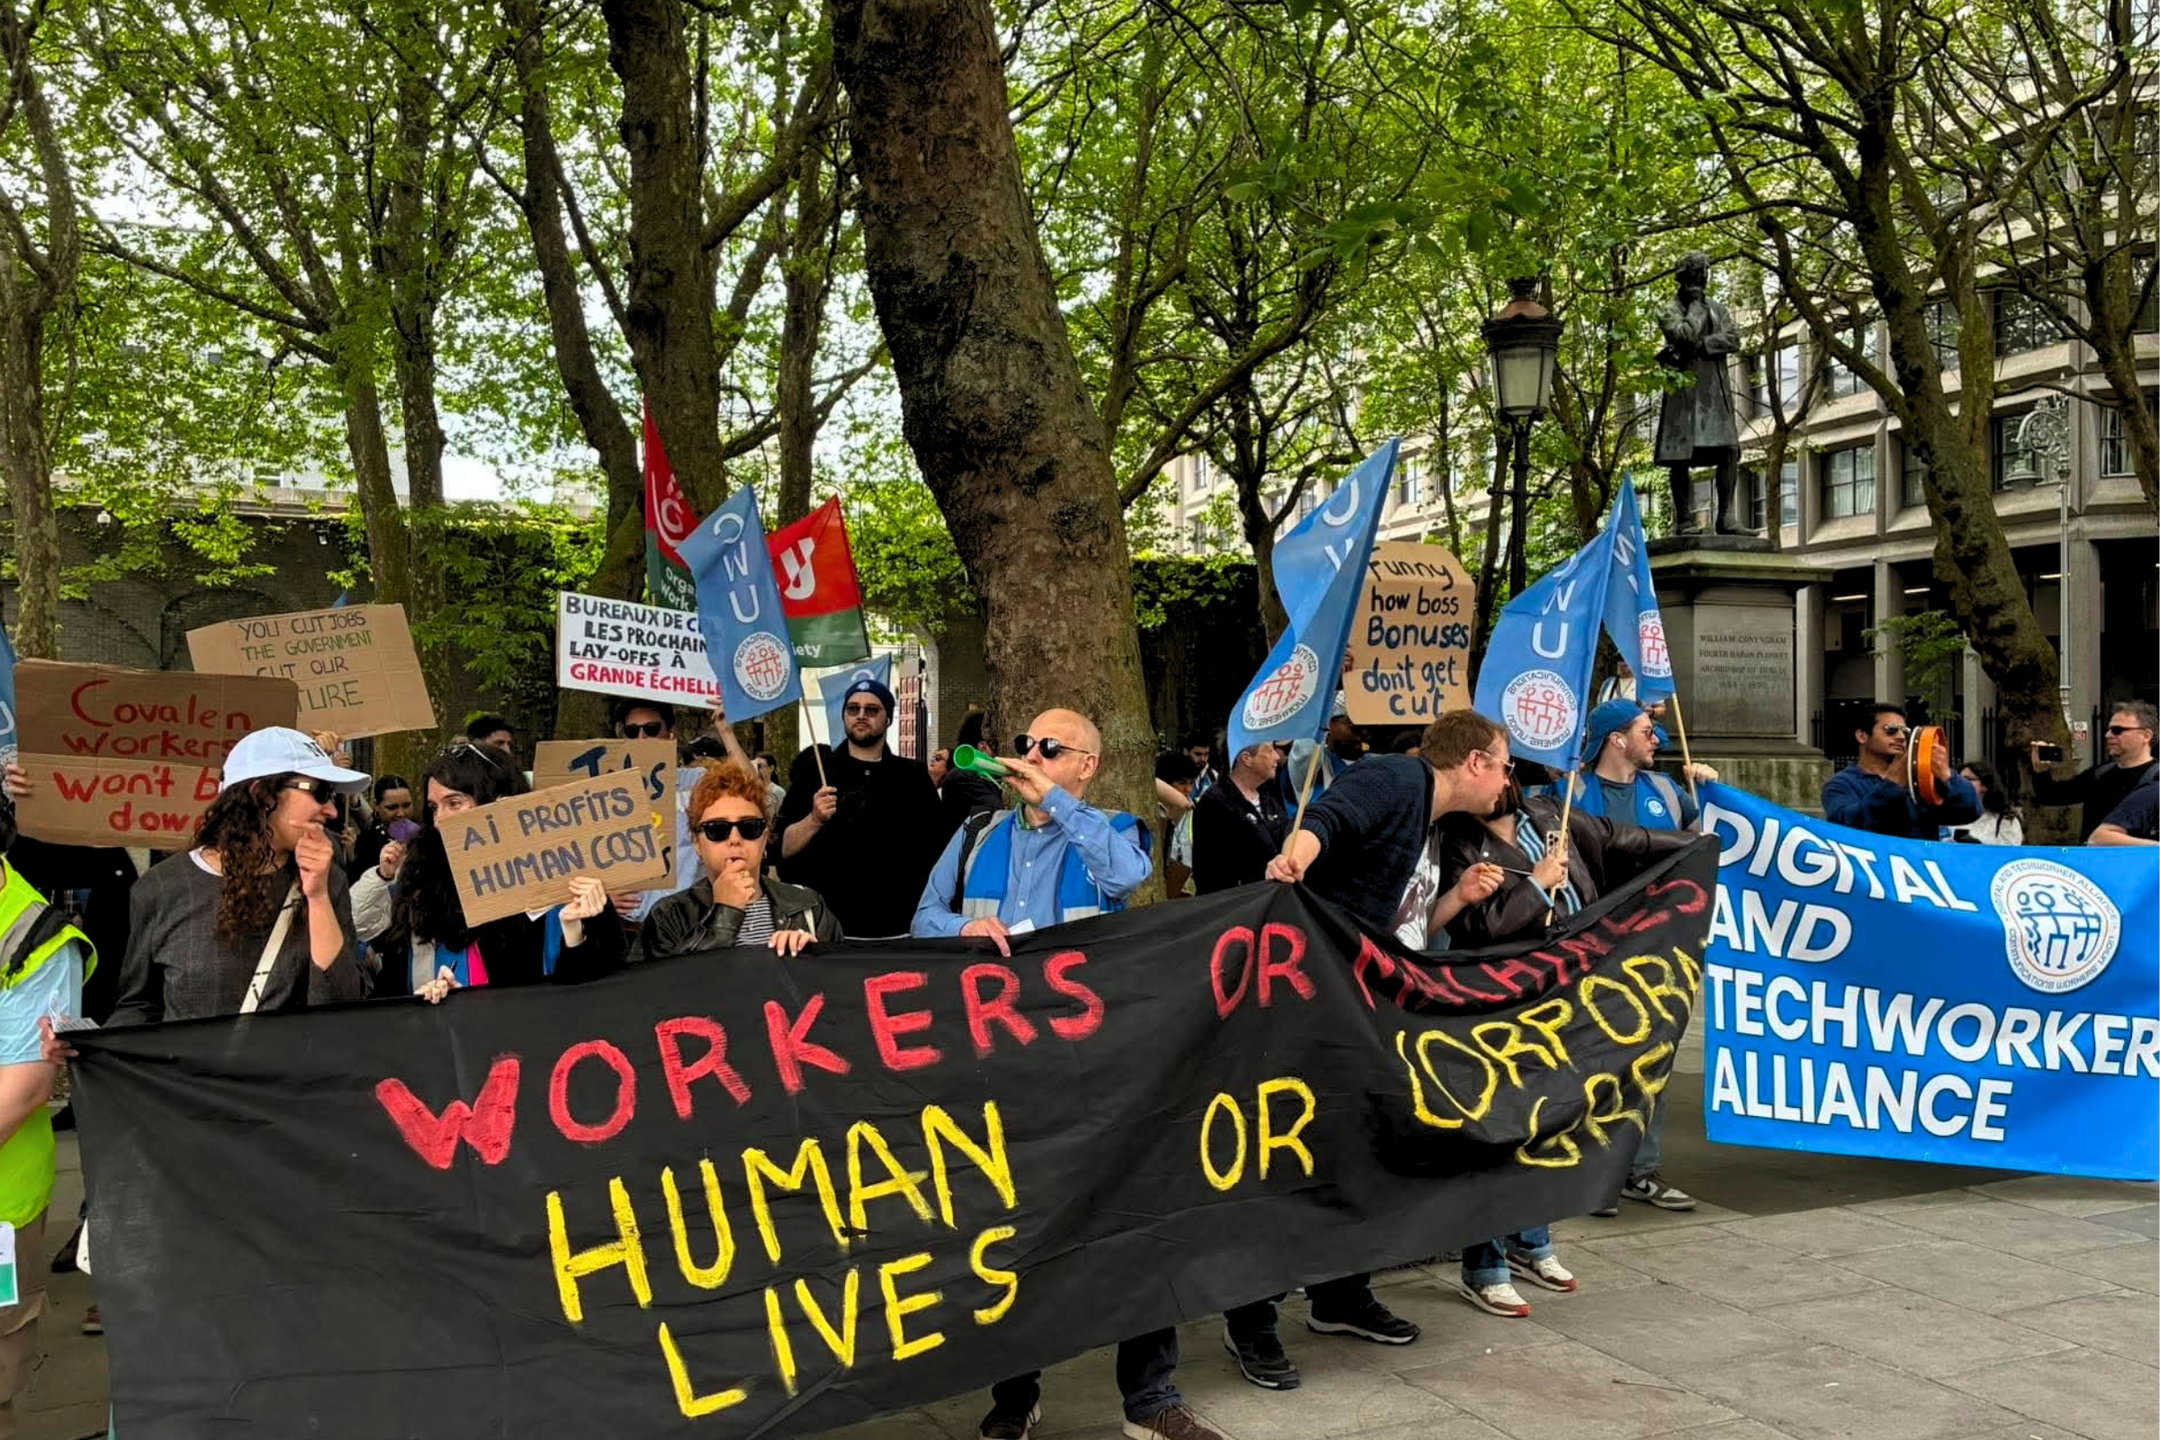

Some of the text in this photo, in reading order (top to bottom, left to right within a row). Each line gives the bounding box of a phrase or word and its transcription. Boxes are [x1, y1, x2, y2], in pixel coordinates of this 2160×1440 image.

[565, 595, 660, 627] BUREAUX
[663, 613, 683, 631] DE
[1371, 585, 1459, 616] how boss
[238, 610, 367, 641] YOU CUT JOBS
[584, 621, 623, 643] LES
[1367, 615, 1470, 649] Bonuses
[241, 630, 373, 662] THE GOVERNMENT
[569, 641, 687, 669] LAY-OFFS À
[310, 656, 349, 675] OUR
[570, 662, 645, 688] GRANDE
[1421, 655, 1460, 693] get
[70, 678, 252, 732] Covalen
[298, 680, 364, 712] TURE
[1389, 687, 1445, 719] cut
[470, 841, 586, 896] HUMAN
[591, 824, 656, 870] COST
[1701, 802, 1979, 913] DIGITAL
[1707, 884, 1853, 962] AND
[1707, 962, 2160, 1080] TECHWORKER
[375, 952, 1104, 1171] WORKERS
[1209, 922, 1316, 1019] OR
[1711, 1047, 2014, 1142] ALLIANCE
[546, 946, 1702, 1324] HUMAN OR CORPORA
[659, 1226, 1019, 1419] LIVES
